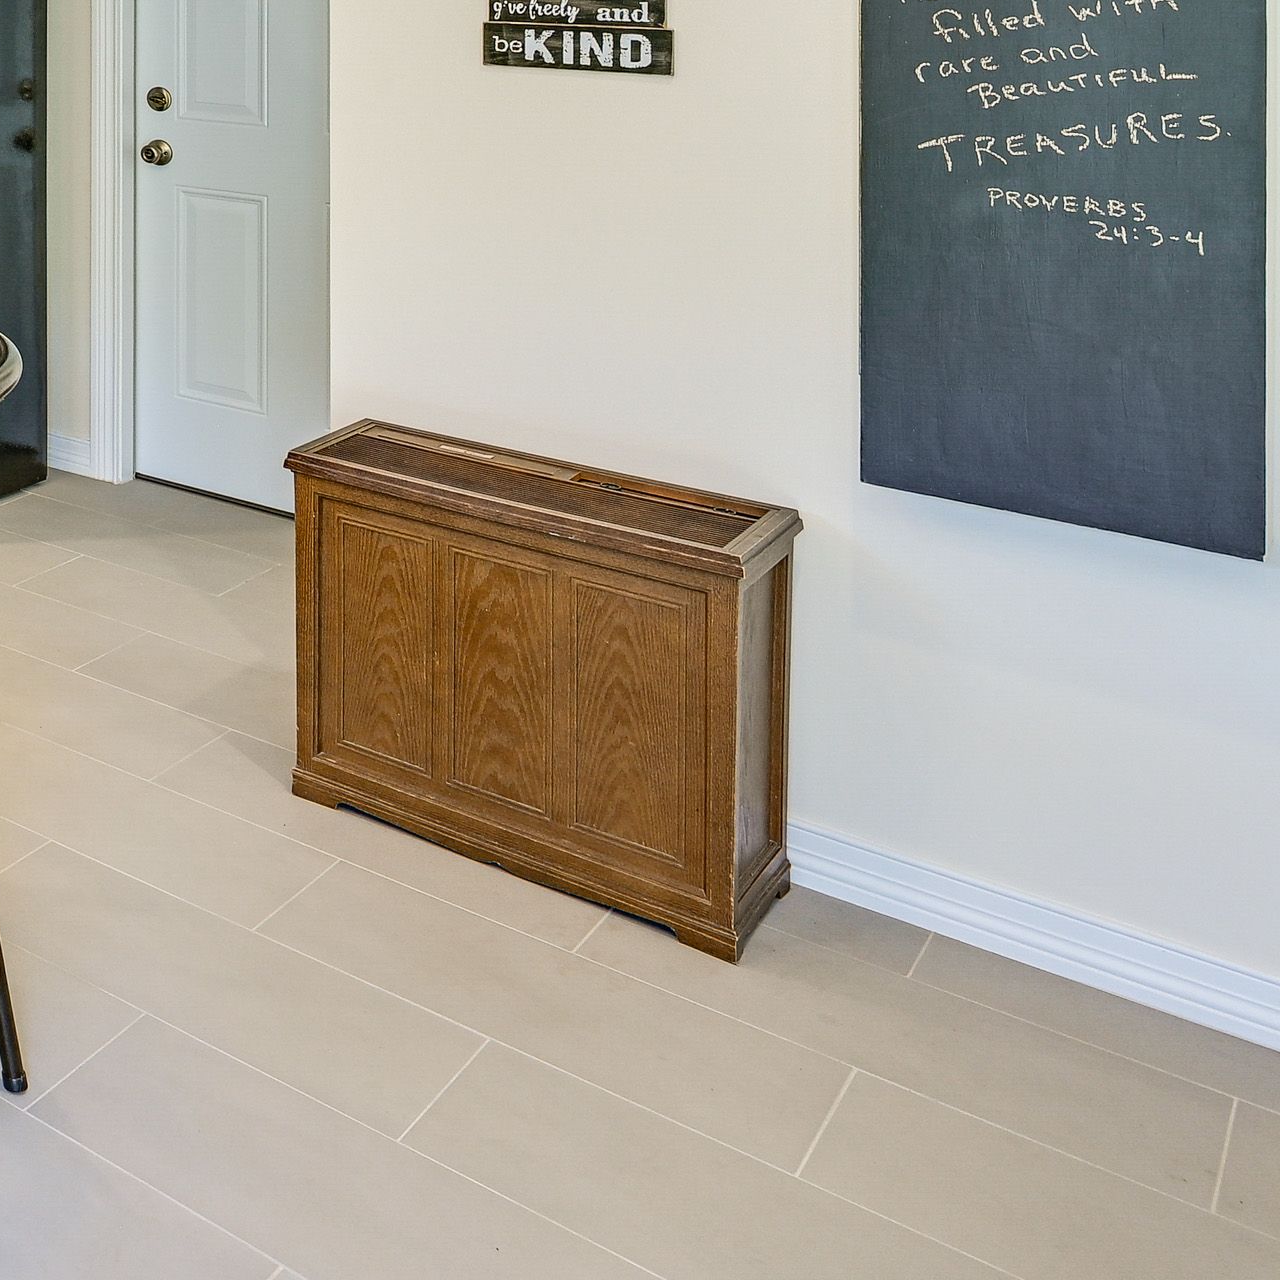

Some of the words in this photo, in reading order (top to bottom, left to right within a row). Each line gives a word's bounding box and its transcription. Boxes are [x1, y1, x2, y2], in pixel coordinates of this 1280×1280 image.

[596, 1, 652, 23] and
[931, 0, 1046, 43] filled
[492, 35, 523, 55] be
[524, 28, 652, 69] KIND
[914, 54, 1000, 84] rare
[1020, 32, 1100, 66] and
[987, 187, 1147, 222] PROVERBS
[1088, 220, 1206, 256] 24:3-4
